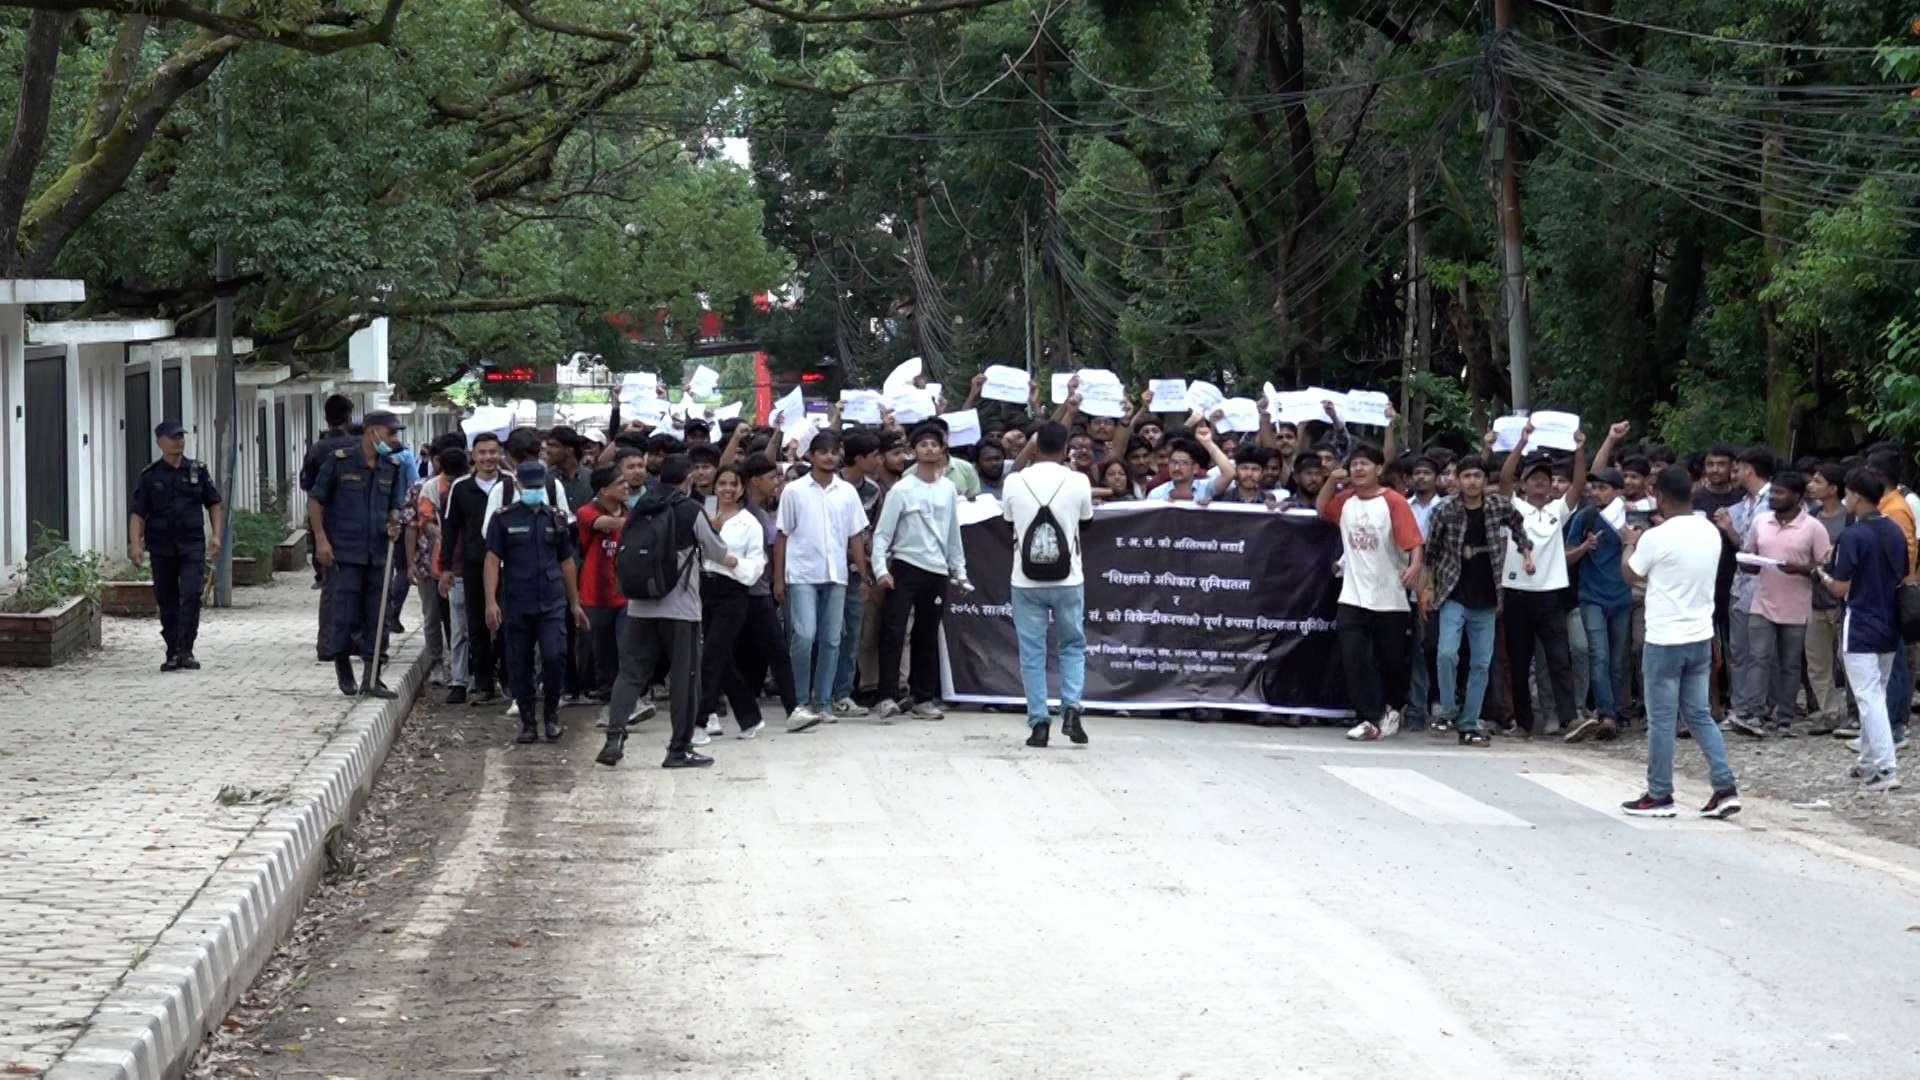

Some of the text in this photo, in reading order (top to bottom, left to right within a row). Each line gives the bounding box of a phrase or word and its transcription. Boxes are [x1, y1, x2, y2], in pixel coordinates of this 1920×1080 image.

[1153, 571, 1197, 588] अधिकार
[1172, 595, 1181, 606] र
[949, 602, 979, 616] २०५५
[1106, 608, 1121, 623] को
[1203, 612, 1222, 631] पूर्ण
